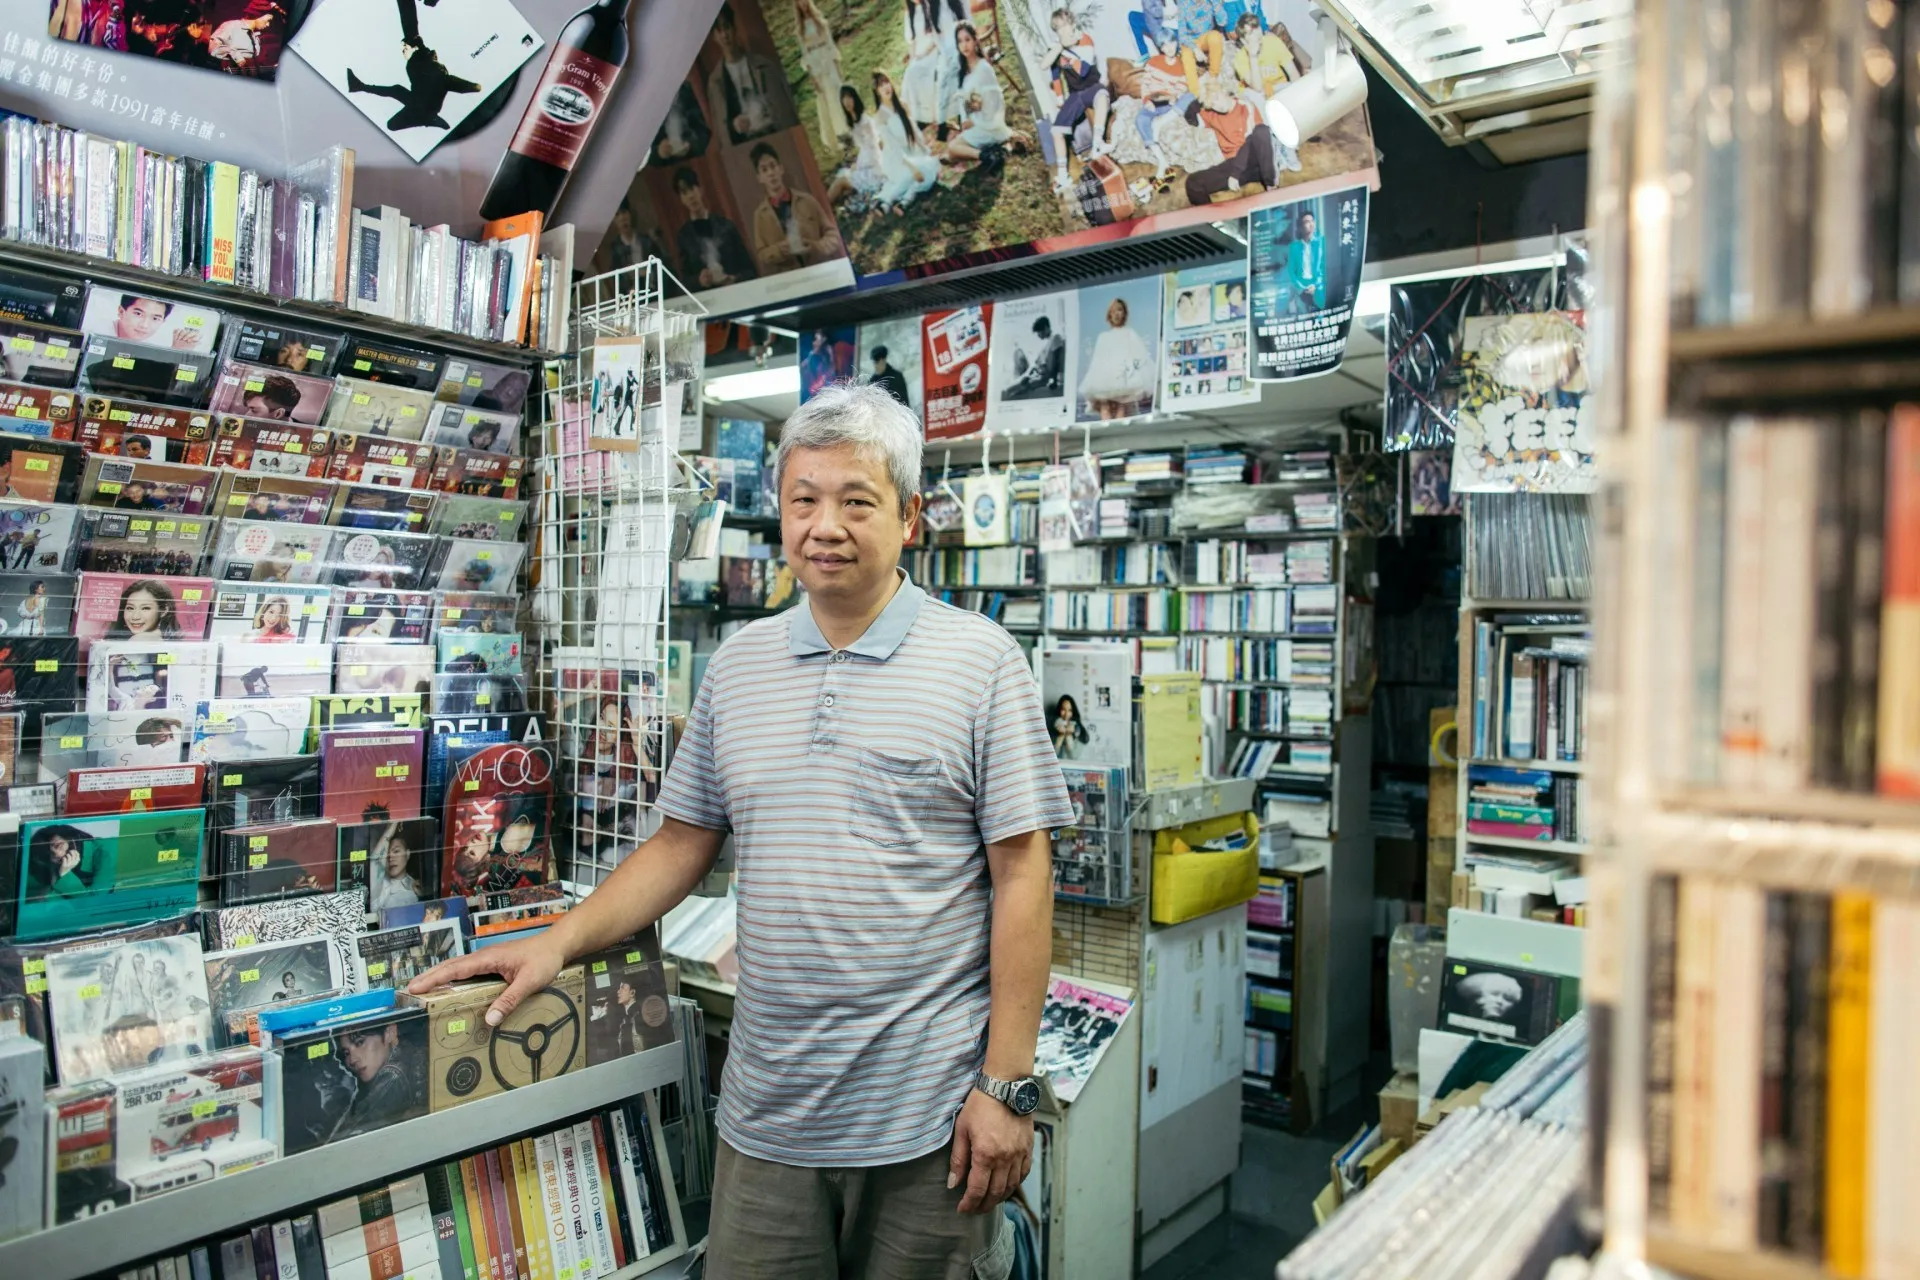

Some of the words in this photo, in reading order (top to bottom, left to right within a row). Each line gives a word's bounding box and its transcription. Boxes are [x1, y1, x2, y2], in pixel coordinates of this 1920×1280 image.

[213, 237, 233, 253] MISS
[213, 250, 228, 266] YOU
[212, 264, 234, 280] MUCH
[358, 348, 378, 360] MASTER
[103, 512, 130, 521] HYBRID
[144, 1090, 162, 1105] 3CD
